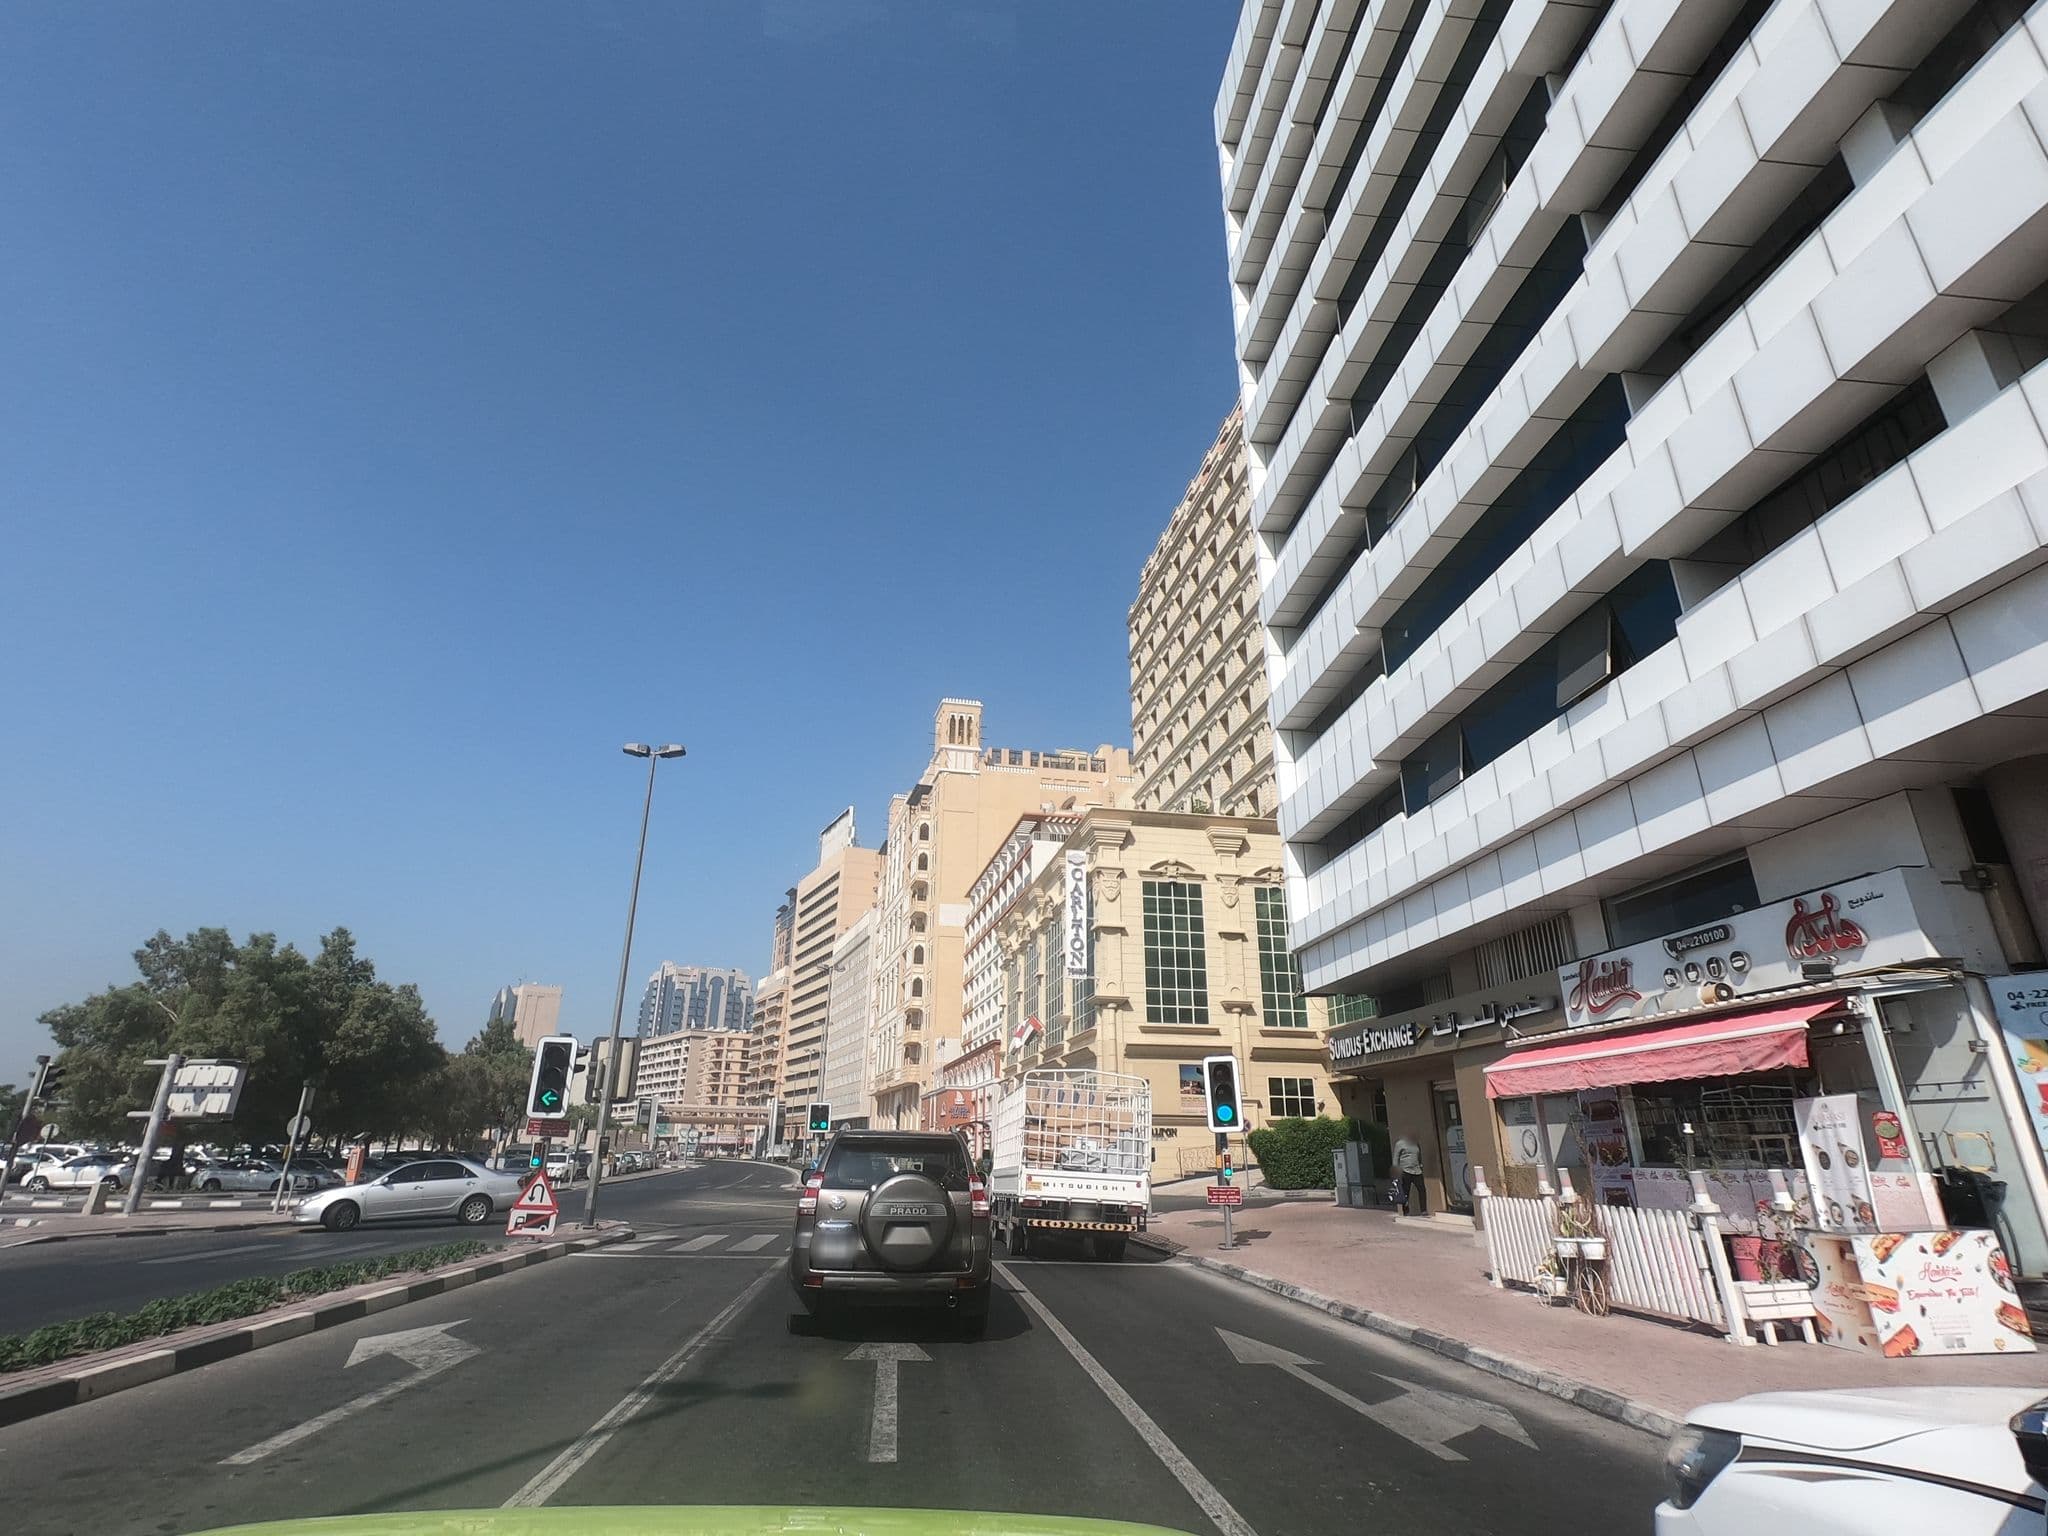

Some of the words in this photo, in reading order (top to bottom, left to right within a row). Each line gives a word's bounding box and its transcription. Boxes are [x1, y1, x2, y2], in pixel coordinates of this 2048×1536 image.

[1070, 867, 1084, 966] CARLTON
[1676, 928, 1725, 950] 04-2210100
[2007, 991, 2025, 1001] 04
[1329, 1036, 1362, 1060] SUNDUS
[1363, 1023, 1414, 1054] EXCHANGE
[1043, 1182, 1126, 1192] MITSUBISHI
[890, 1207, 928, 1215] PRADO
